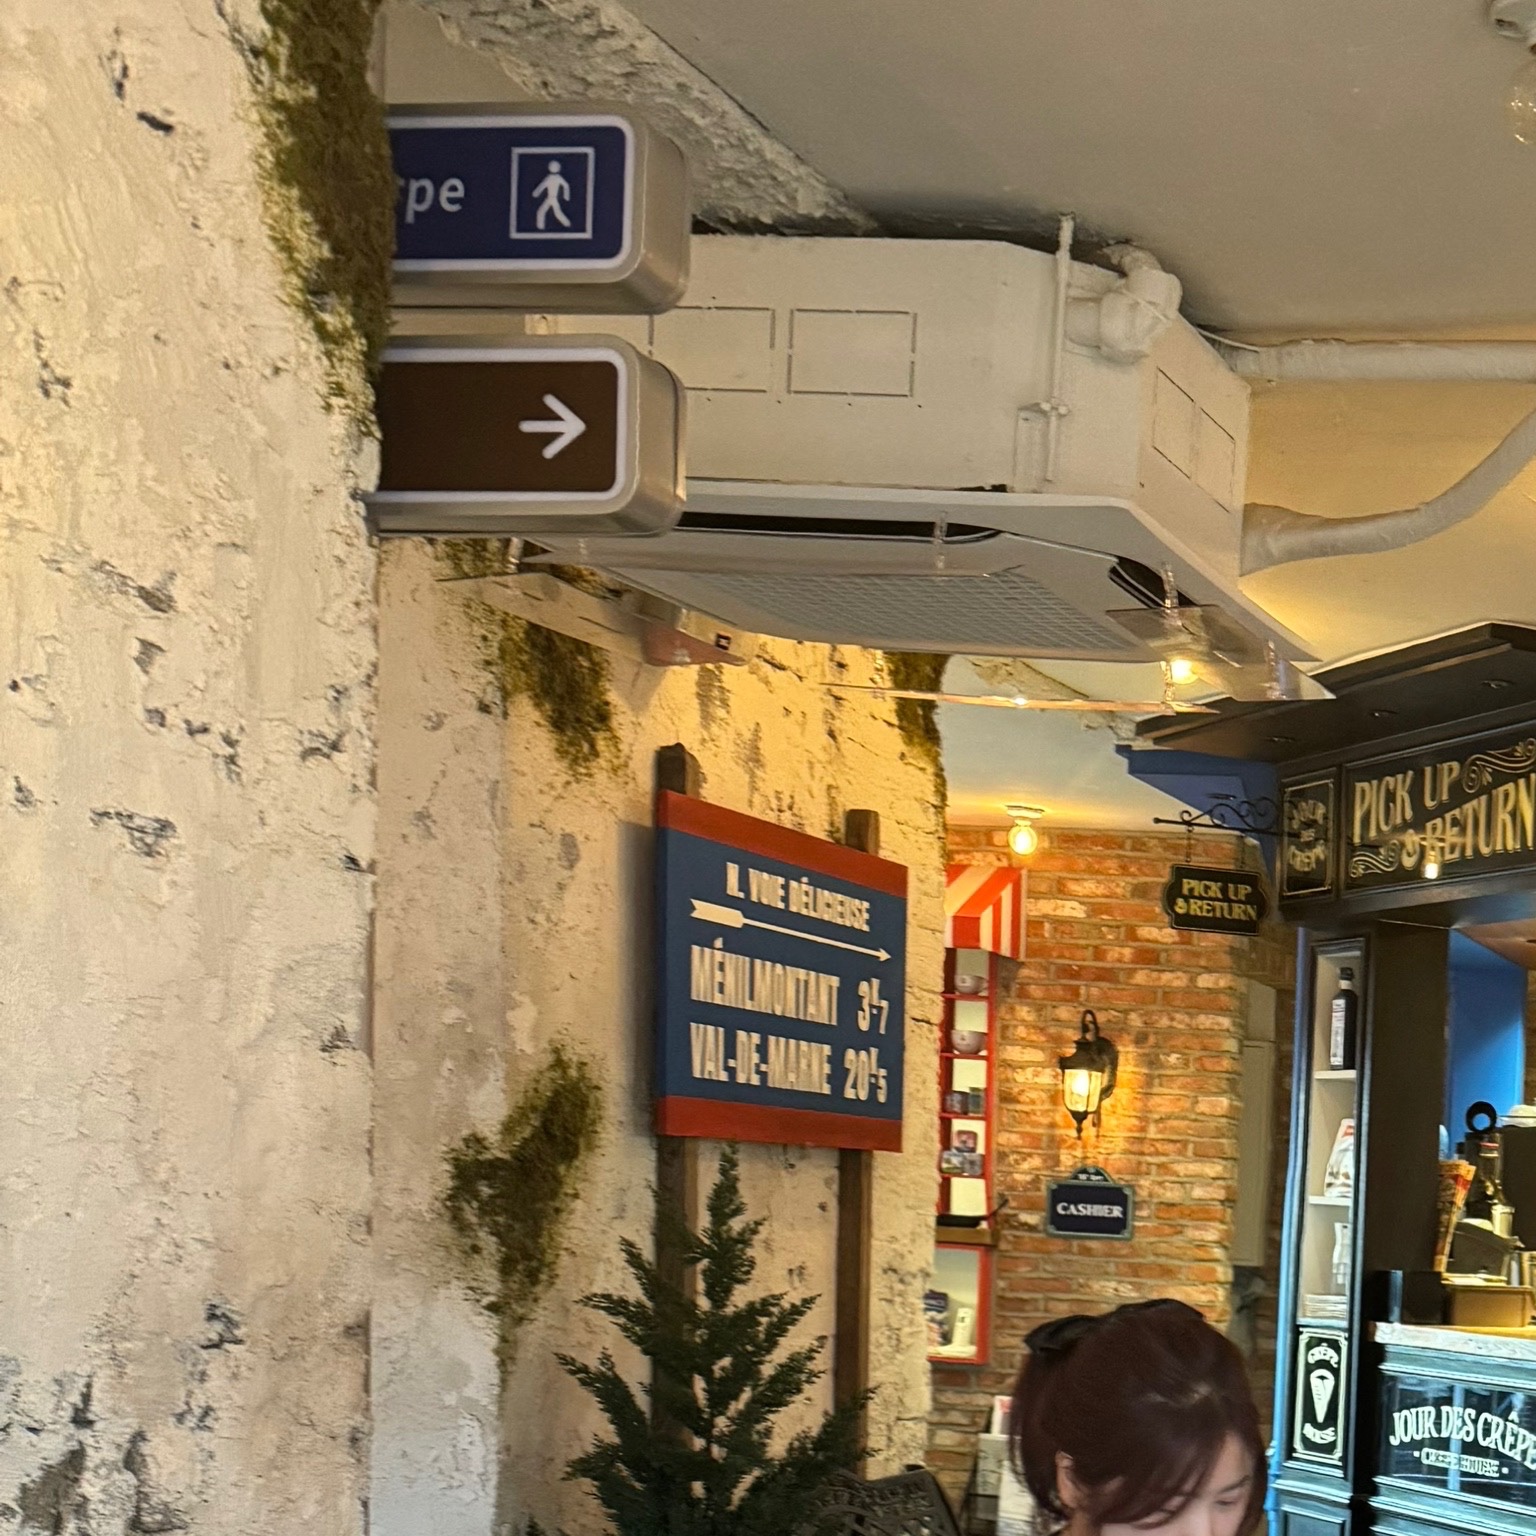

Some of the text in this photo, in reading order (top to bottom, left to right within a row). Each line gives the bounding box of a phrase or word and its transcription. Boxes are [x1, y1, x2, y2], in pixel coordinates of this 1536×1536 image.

[1353, 761, 1461, 847] PICK UP
[1182, 878, 1252, 901] PICK UP
[1190, 899, 1258, 922] RETURN
[691, 937, 841, 1027] MÉNILMONTANT
[1056, 1202, 1123, 1218] CASHIER
[1389, 1406, 1439, 1446] JOUR
[1440, 1405, 1476, 1443] DES
